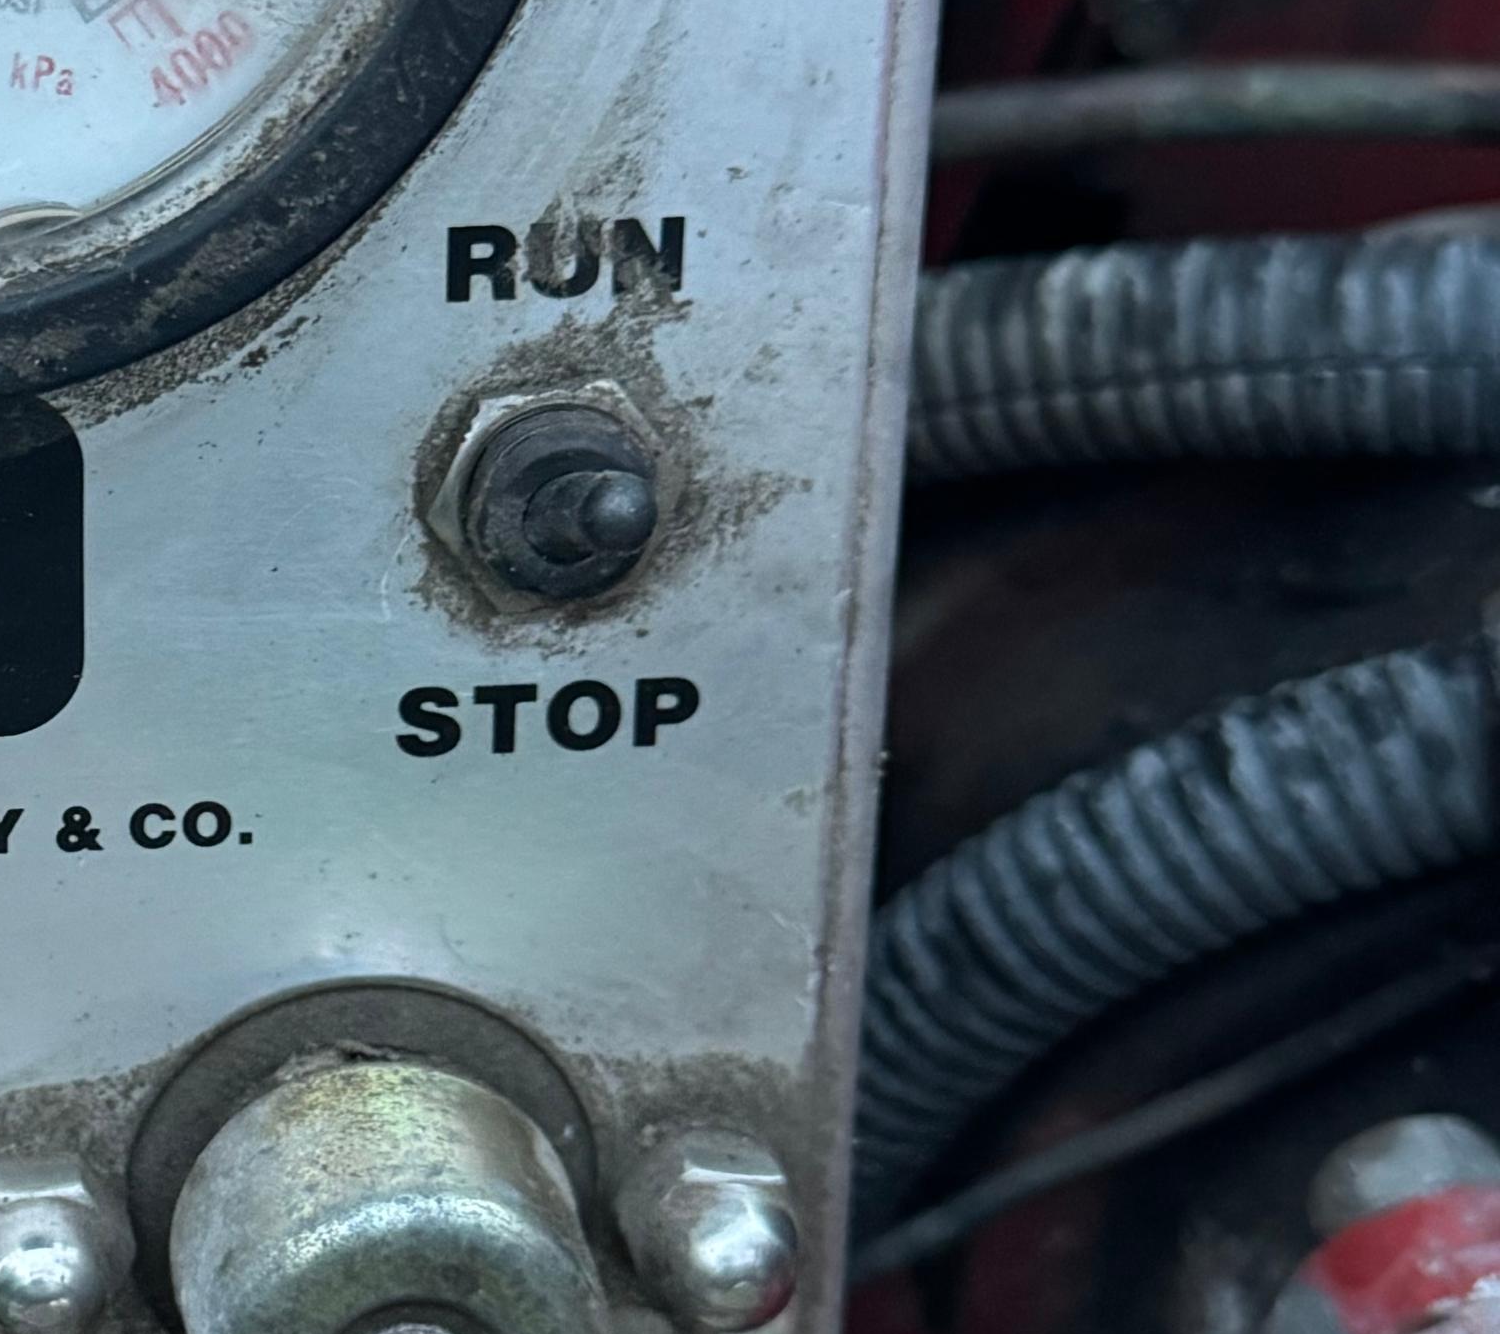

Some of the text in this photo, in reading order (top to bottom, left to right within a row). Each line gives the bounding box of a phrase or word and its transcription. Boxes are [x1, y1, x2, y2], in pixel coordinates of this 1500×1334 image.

[9, 52, 74, 96] kPa
[149, 10, 255, 108] 4000
[446, 216, 685, 302] RUN
[395, 677, 700, 757] STOP
[56, 806, 103, 852] &
[129, 802, 253, 848] CO.
